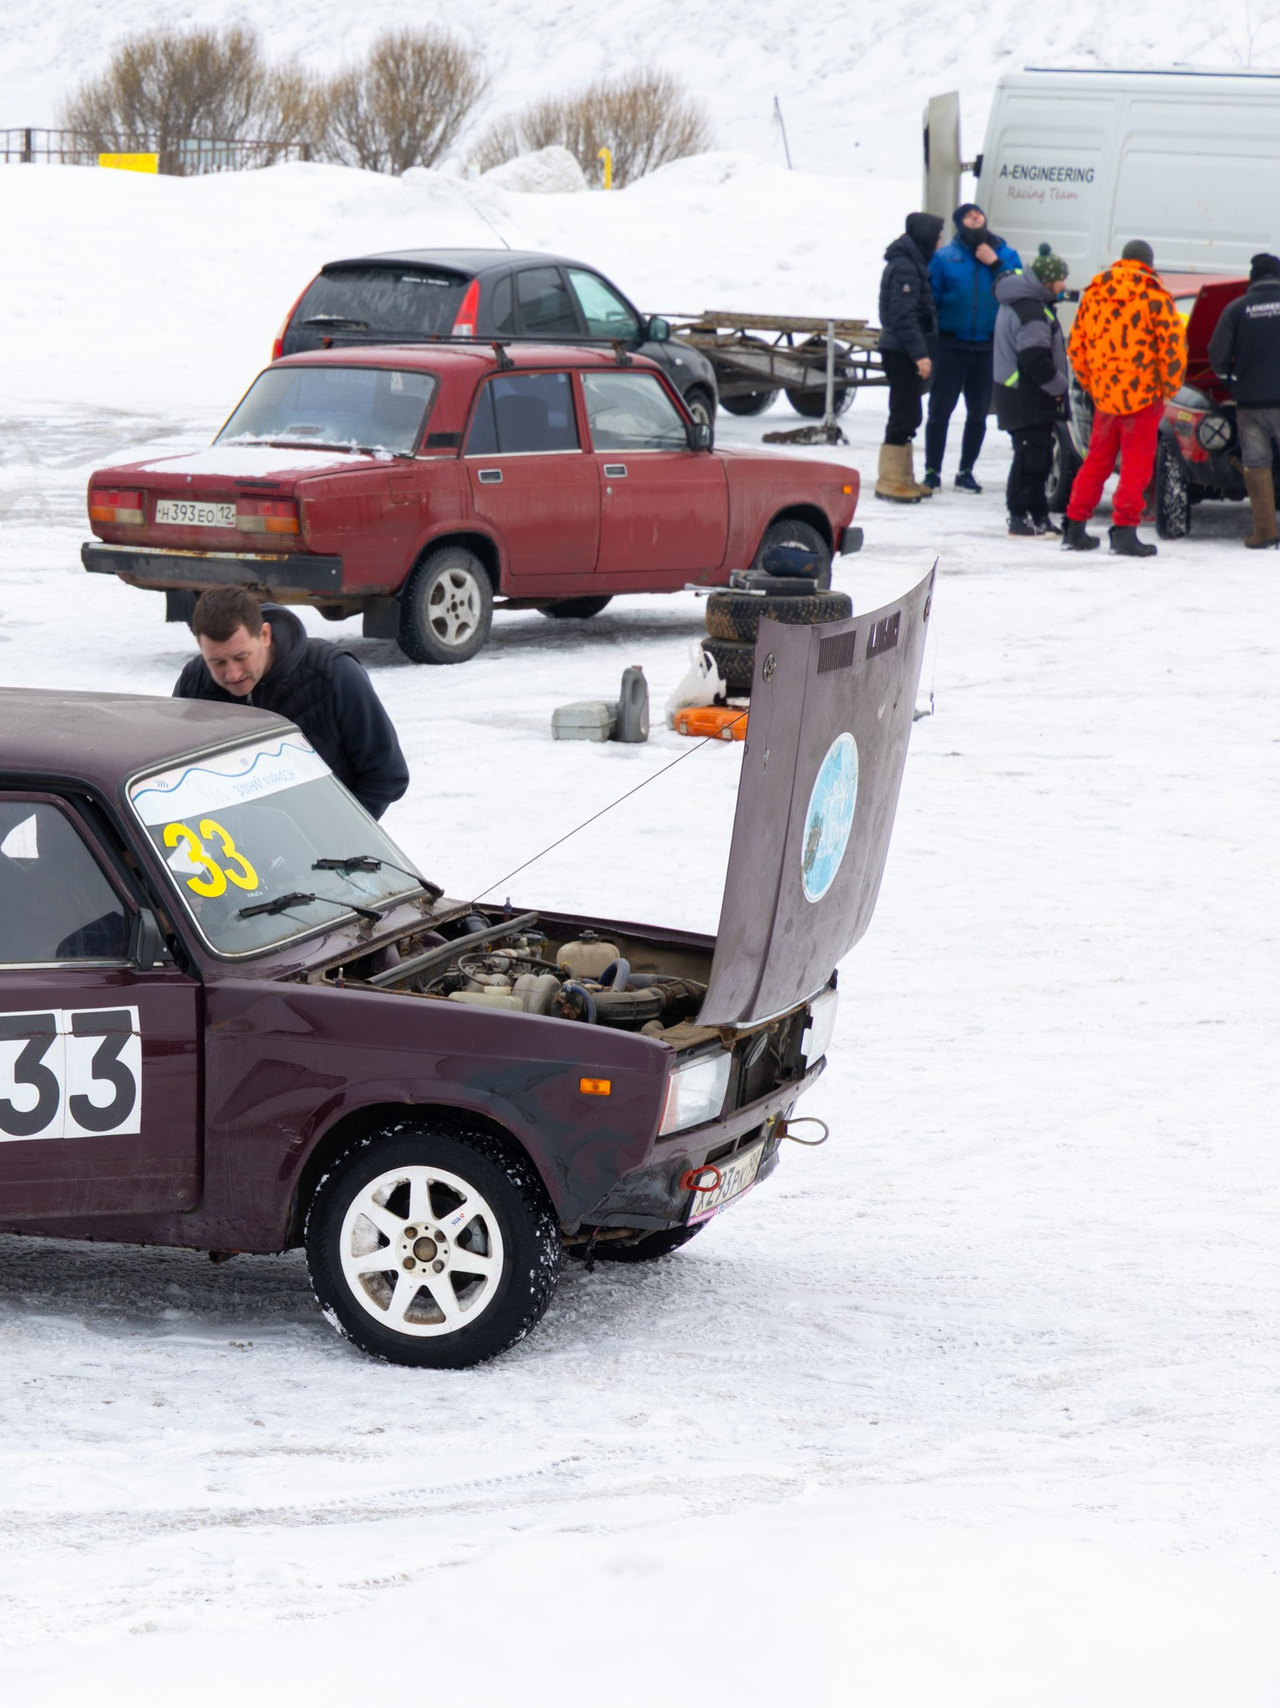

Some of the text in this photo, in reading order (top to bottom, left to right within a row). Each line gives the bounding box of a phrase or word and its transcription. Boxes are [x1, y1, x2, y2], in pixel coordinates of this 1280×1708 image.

[1000, 164, 1095, 183] A-ENGINEERING
[1006, 186, 1079, 204] Racing Team
[163, 818, 259, 898] 33
